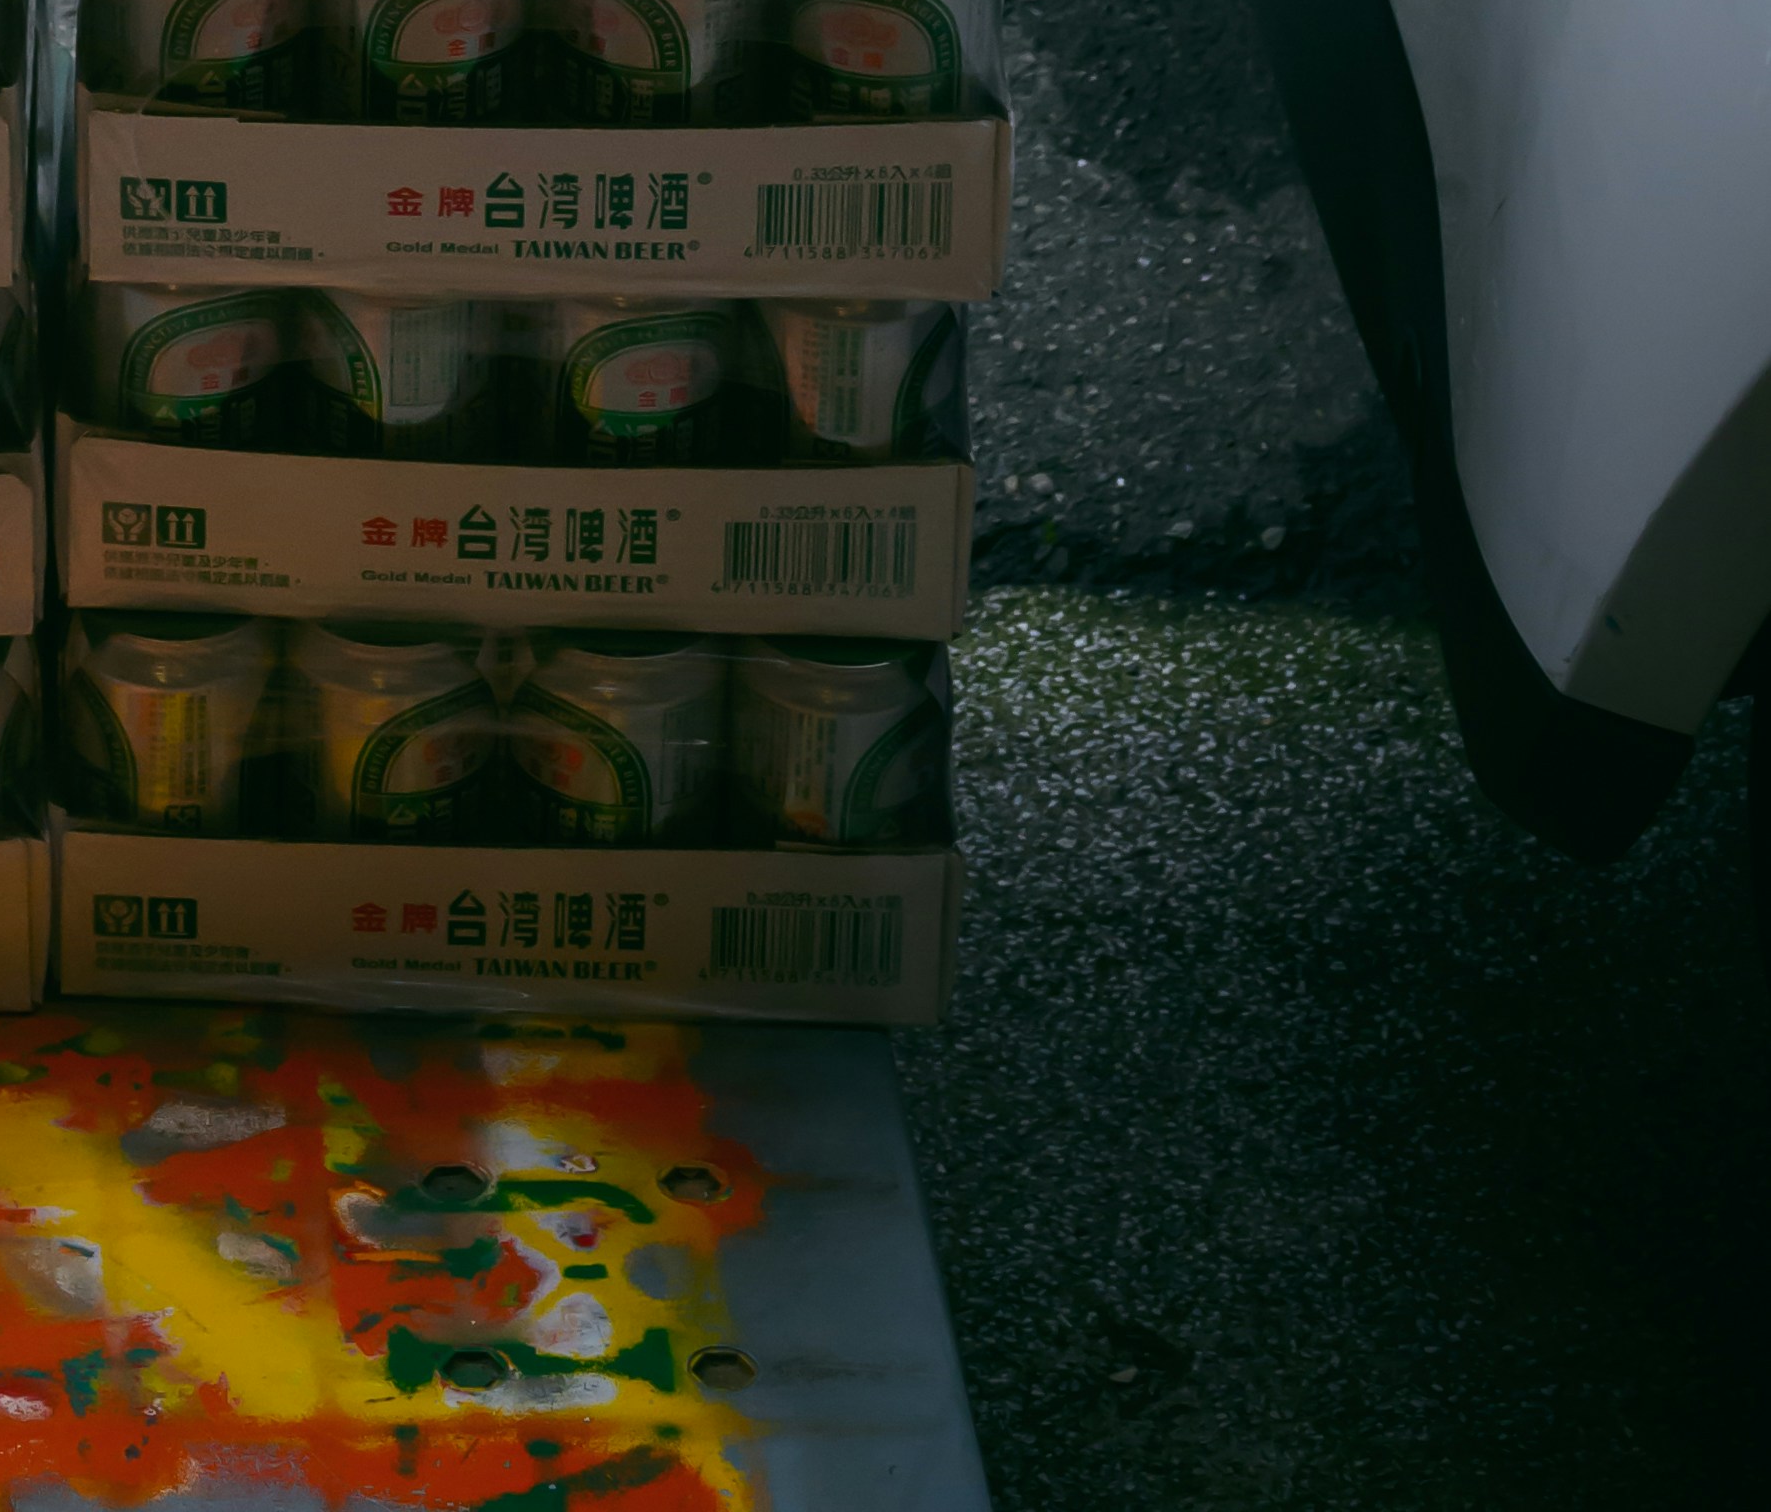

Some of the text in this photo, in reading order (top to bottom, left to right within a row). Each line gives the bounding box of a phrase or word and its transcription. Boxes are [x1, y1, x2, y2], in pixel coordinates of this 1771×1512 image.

[386, 186, 475, 218] 金牌
[386, 240, 687, 261] Gold Medal TAIWAN BEER
[361, 516, 449, 549] 金牌
[360, 570, 656, 594] Gold Medal TAIWAN BEER
[351, 902, 438, 935] 金牌
[351, 957, 644, 981] Gold Medal TAIWAN BEER
